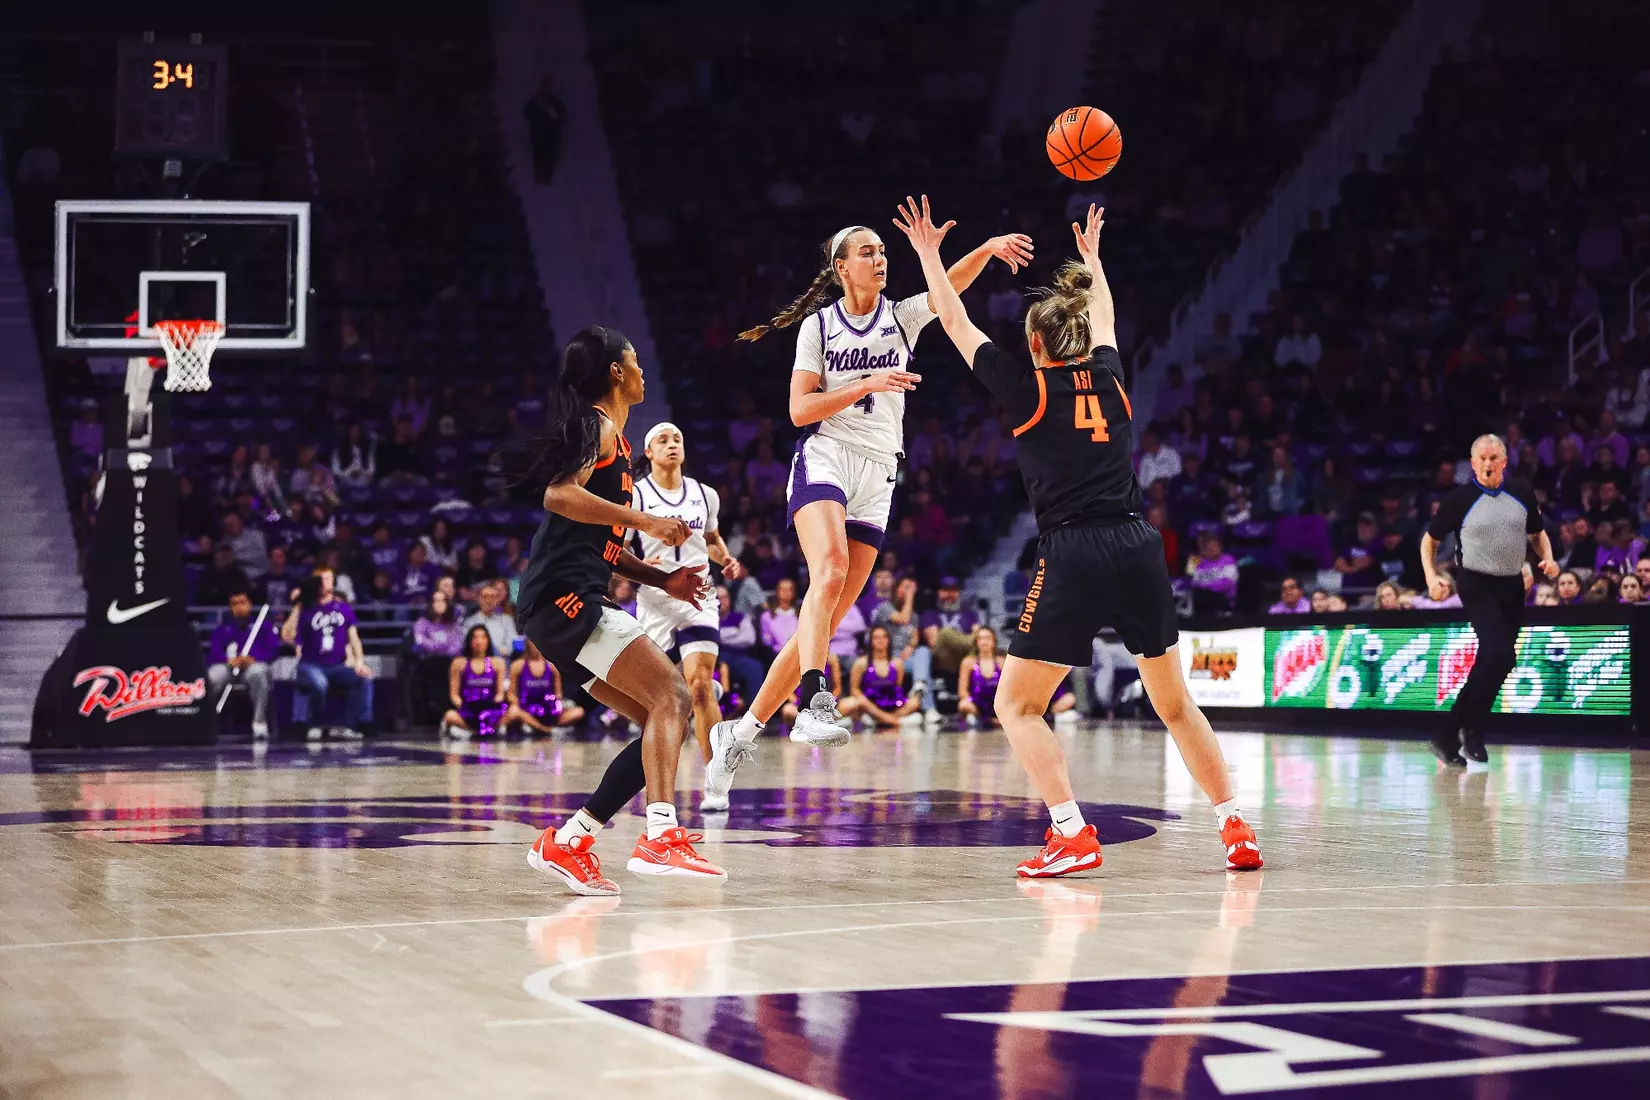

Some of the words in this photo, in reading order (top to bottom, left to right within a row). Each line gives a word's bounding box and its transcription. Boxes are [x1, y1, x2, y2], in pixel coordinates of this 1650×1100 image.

[152, 59, 193, 90] 3.4
[825, 346, 901, 372] Wildcats
[1072, 370, 1093, 391] ASI
[1074, 394, 1110, 442] 4
[132, 475, 147, 595] WILDCATS
[1018, 558, 1047, 634] COWGIRLS
[73, 665, 206, 720] Dillons
